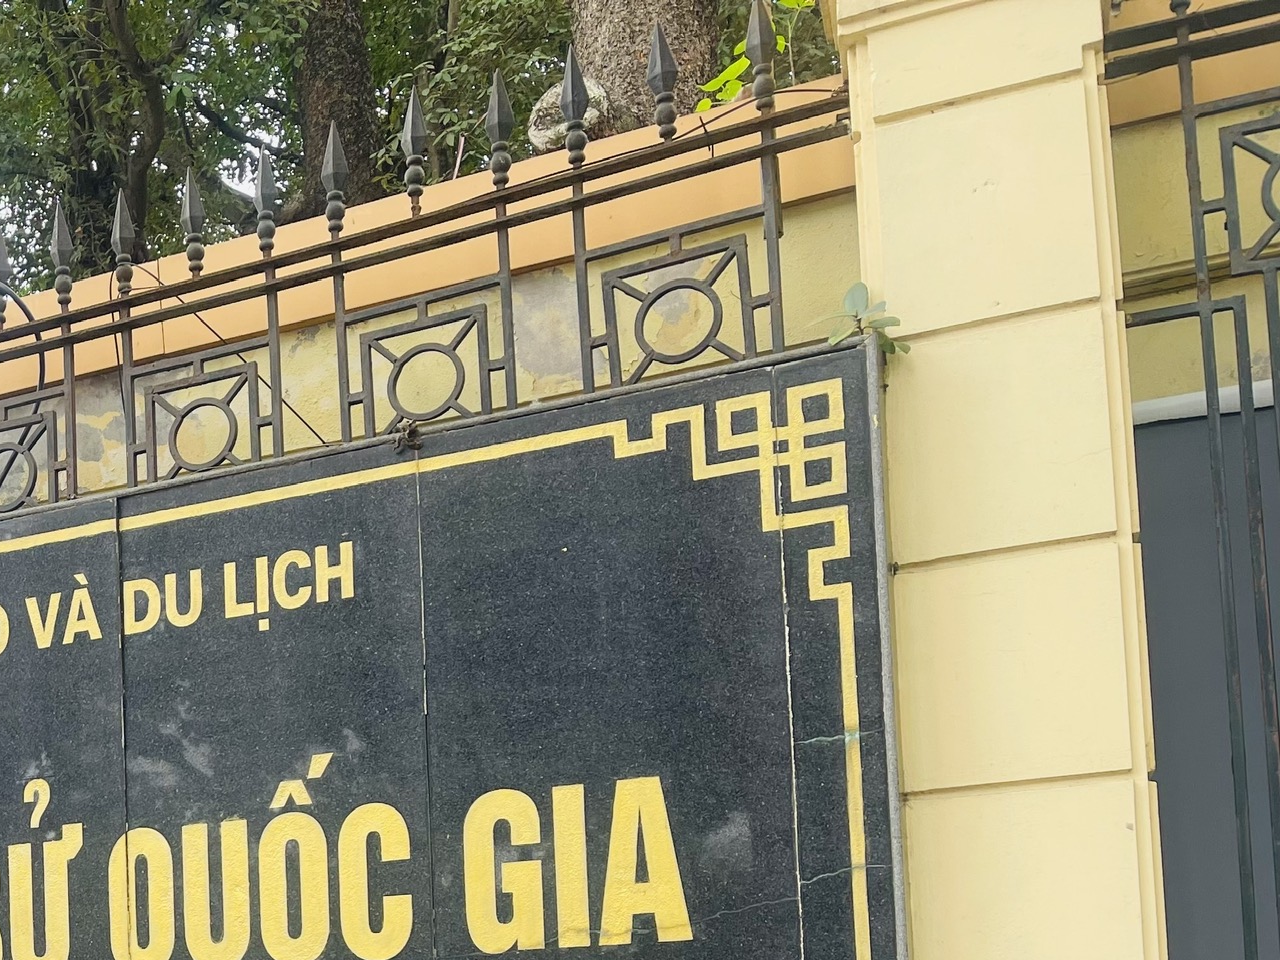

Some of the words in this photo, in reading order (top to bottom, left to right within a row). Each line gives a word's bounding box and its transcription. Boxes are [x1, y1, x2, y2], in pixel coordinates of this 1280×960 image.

[24, 572, 103, 649] VÀ
[123, 568, 203, 636] DU
[223, 541, 354, 631] LỊCH
[463, 776, 694, 954] GIA
